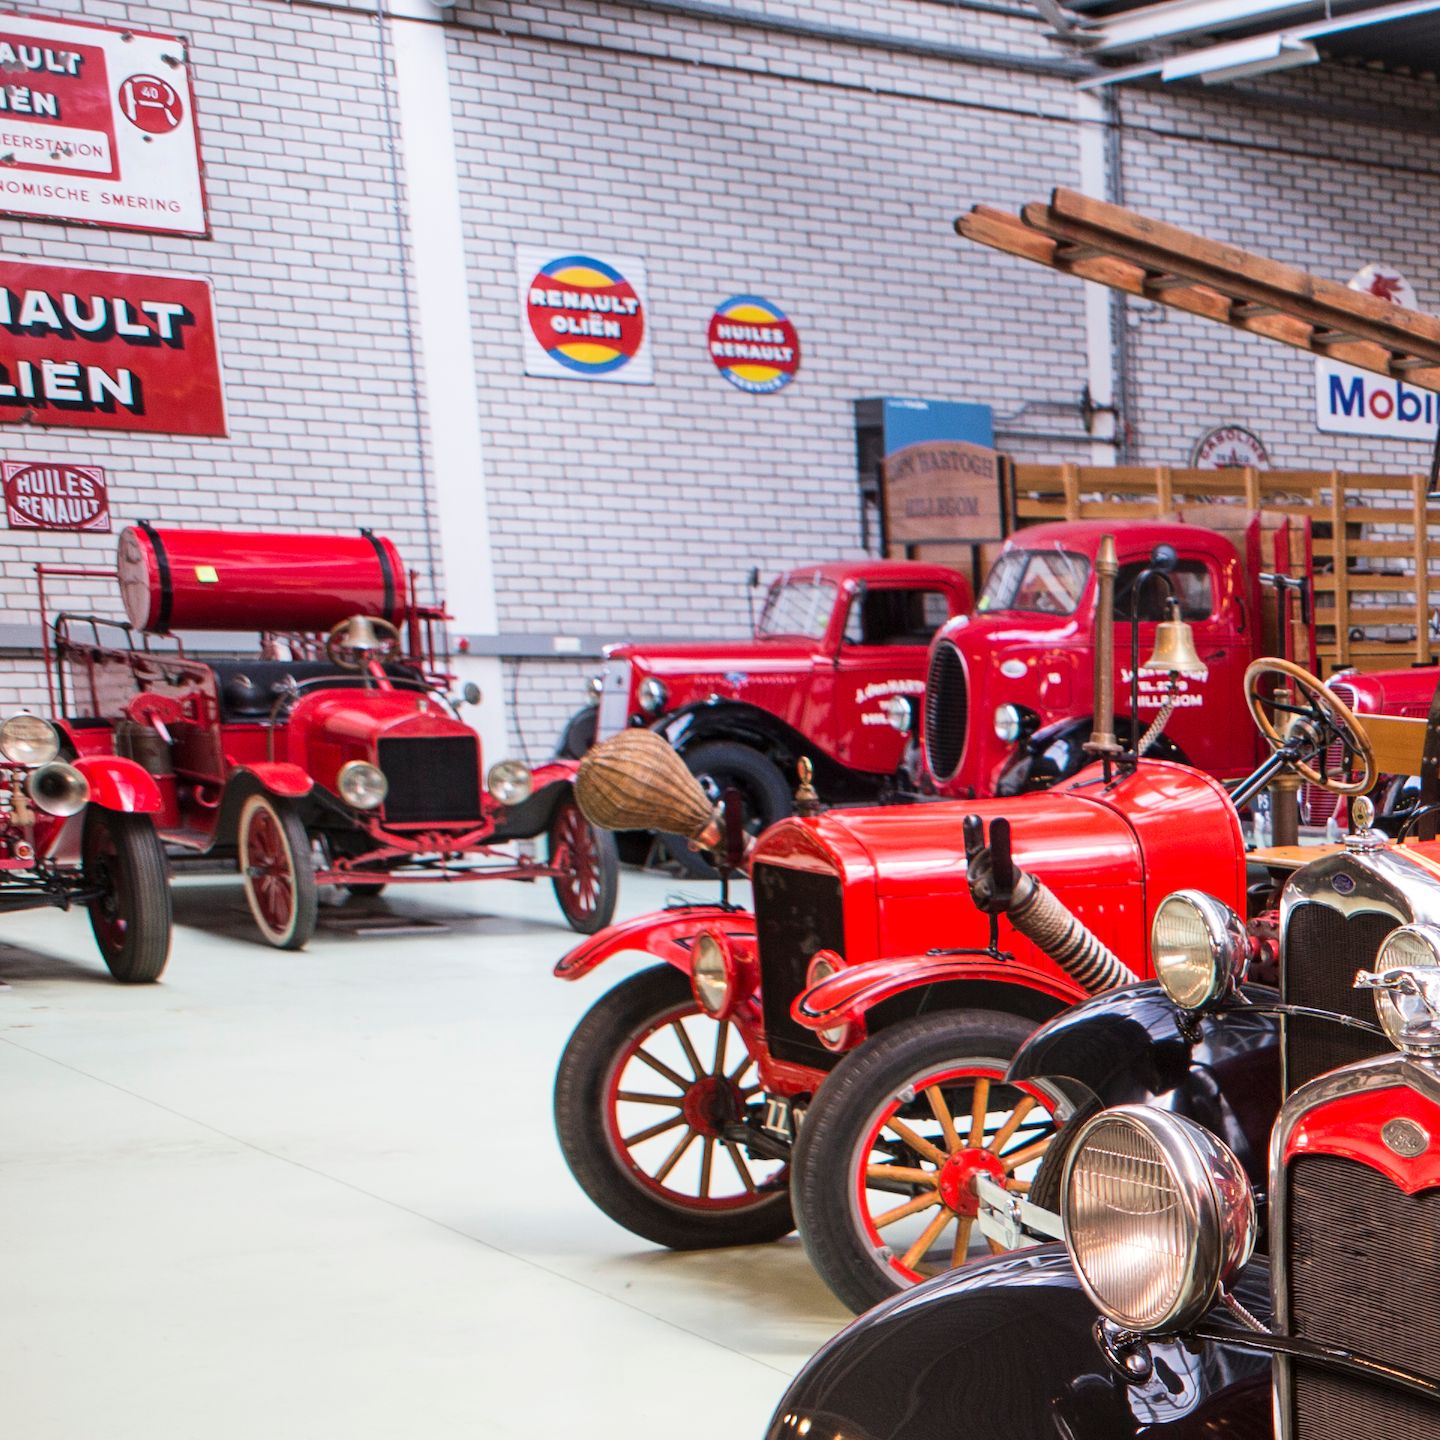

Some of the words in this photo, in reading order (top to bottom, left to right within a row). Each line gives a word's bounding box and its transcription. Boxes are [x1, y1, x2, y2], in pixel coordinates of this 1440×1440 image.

[141, 86, 158, 99] 40
[101, 192, 181, 213] SMERING
[530, 288, 640, 315] RENAULT
[550, 313, 622, 338] OLIËN
[716, 323, 785, 344] HUILES
[710, 342, 794, 362] RENAULT
[1200, 429, 1266, 463] GASOLINE
[17, 469, 95, 498] HUILES
[17, 495, 100, 525] RENAULT
